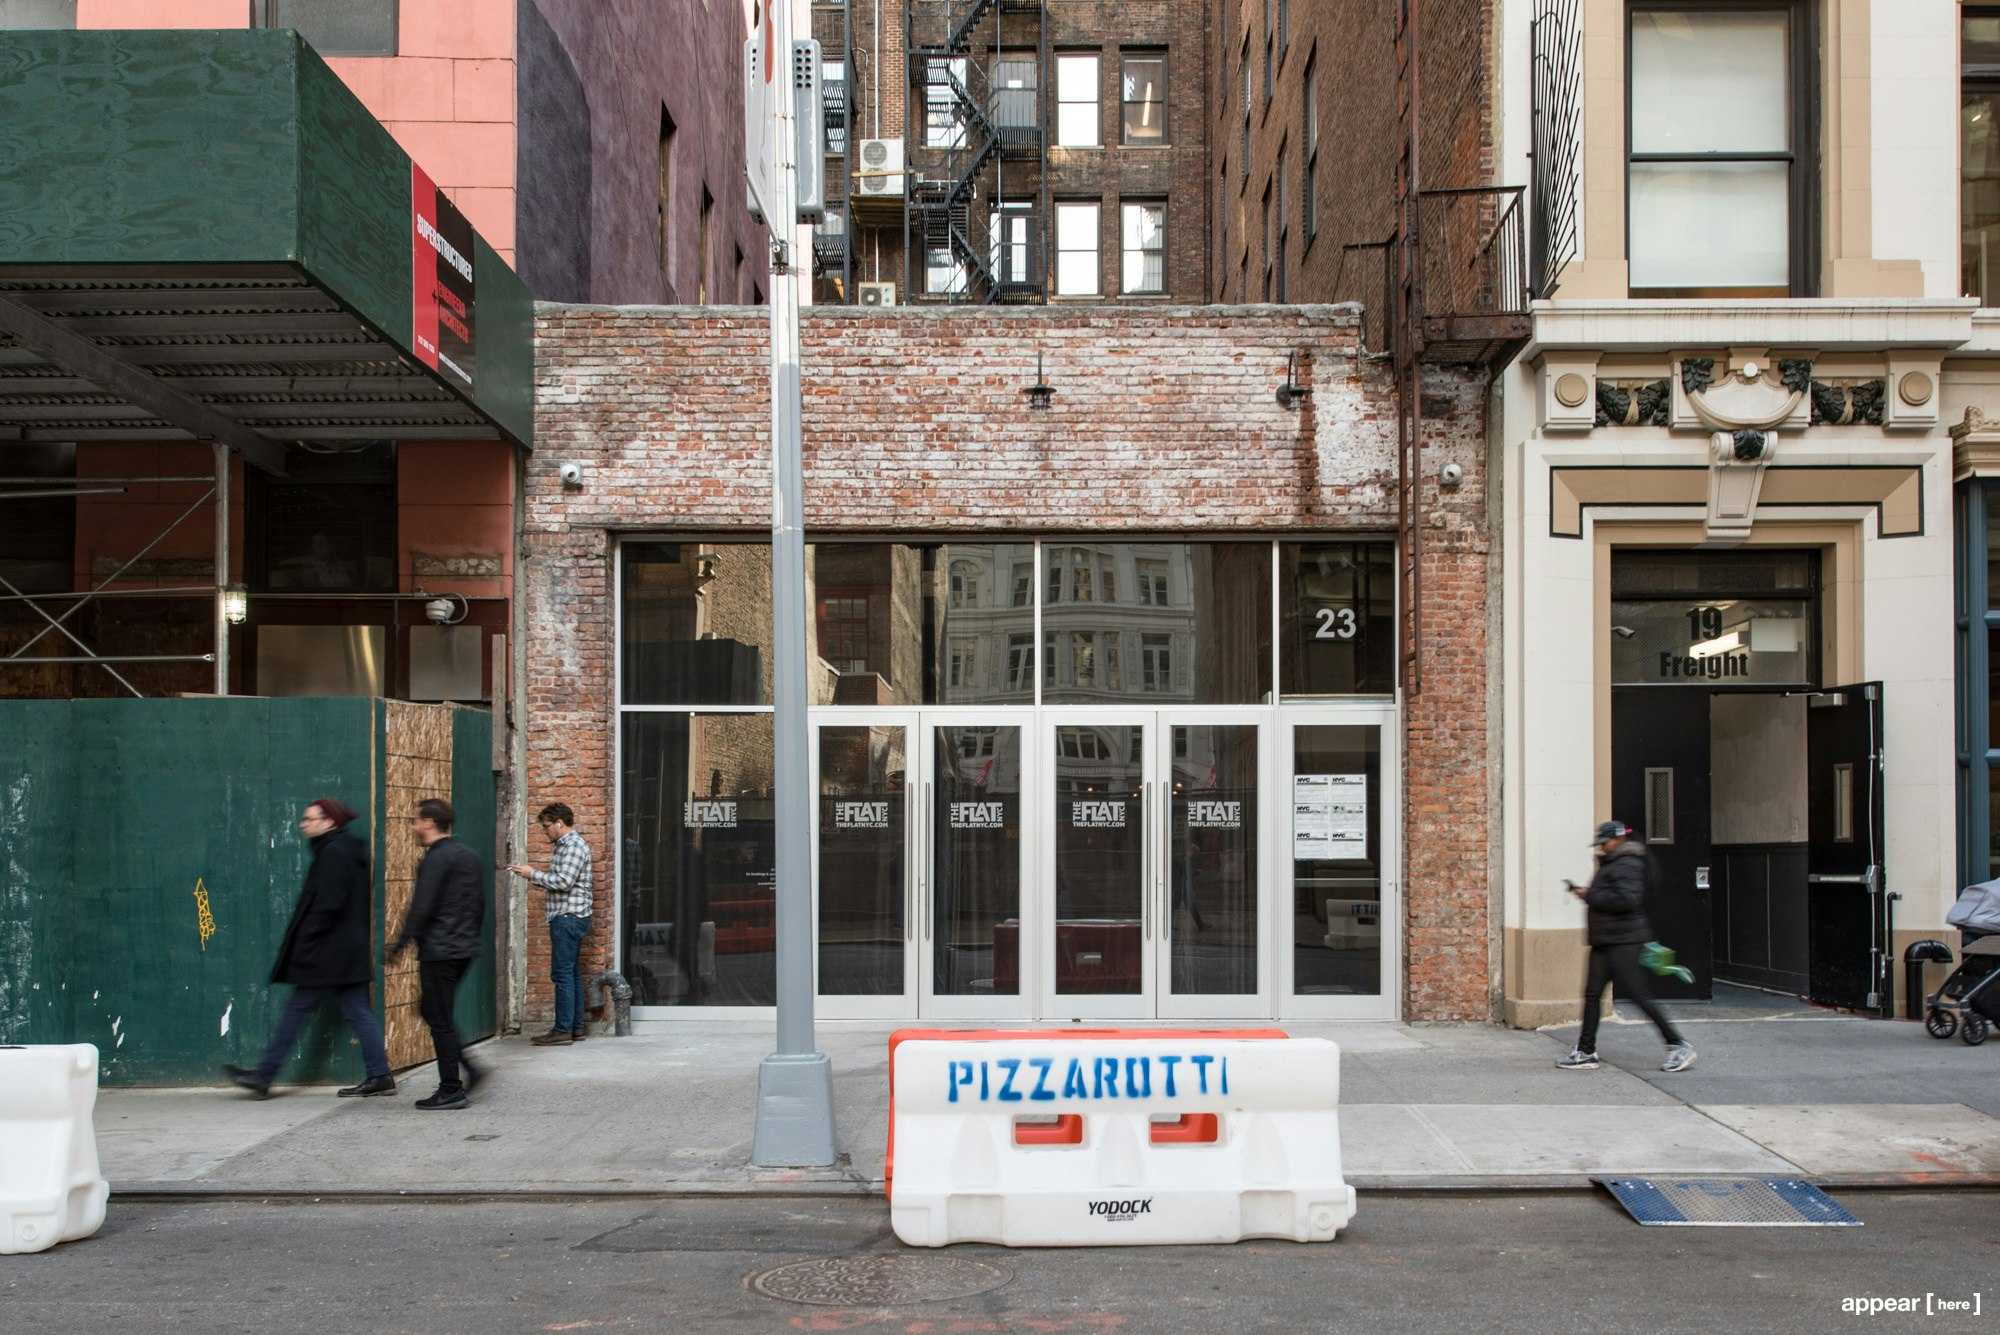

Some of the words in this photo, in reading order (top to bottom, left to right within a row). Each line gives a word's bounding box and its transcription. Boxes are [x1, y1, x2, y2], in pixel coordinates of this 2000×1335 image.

[417, 213, 473, 284] SUPERSTRUCTURES
[1315, 608, 1357, 640] 23
[1686, 607, 1722, 640] 19
[1660, 652, 1749, 680] Freight
[693, 802, 736, 821] FLAT
[835, 802, 844, 822] THE
[844, 802, 888, 822] FLAT
[950, 802, 959, 822] THE
[959, 802, 1003, 822] FLAT
[1072, 801, 1081, 821] THE
[1081, 801, 1125, 821] FLAT
[1188, 801, 1196, 821] THE
[1196, 801, 1240, 821] FLAT
[948, 1056, 1228, 1103] PIZZAROTTI
[1088, 1199, 1152, 1215] YODOCK
